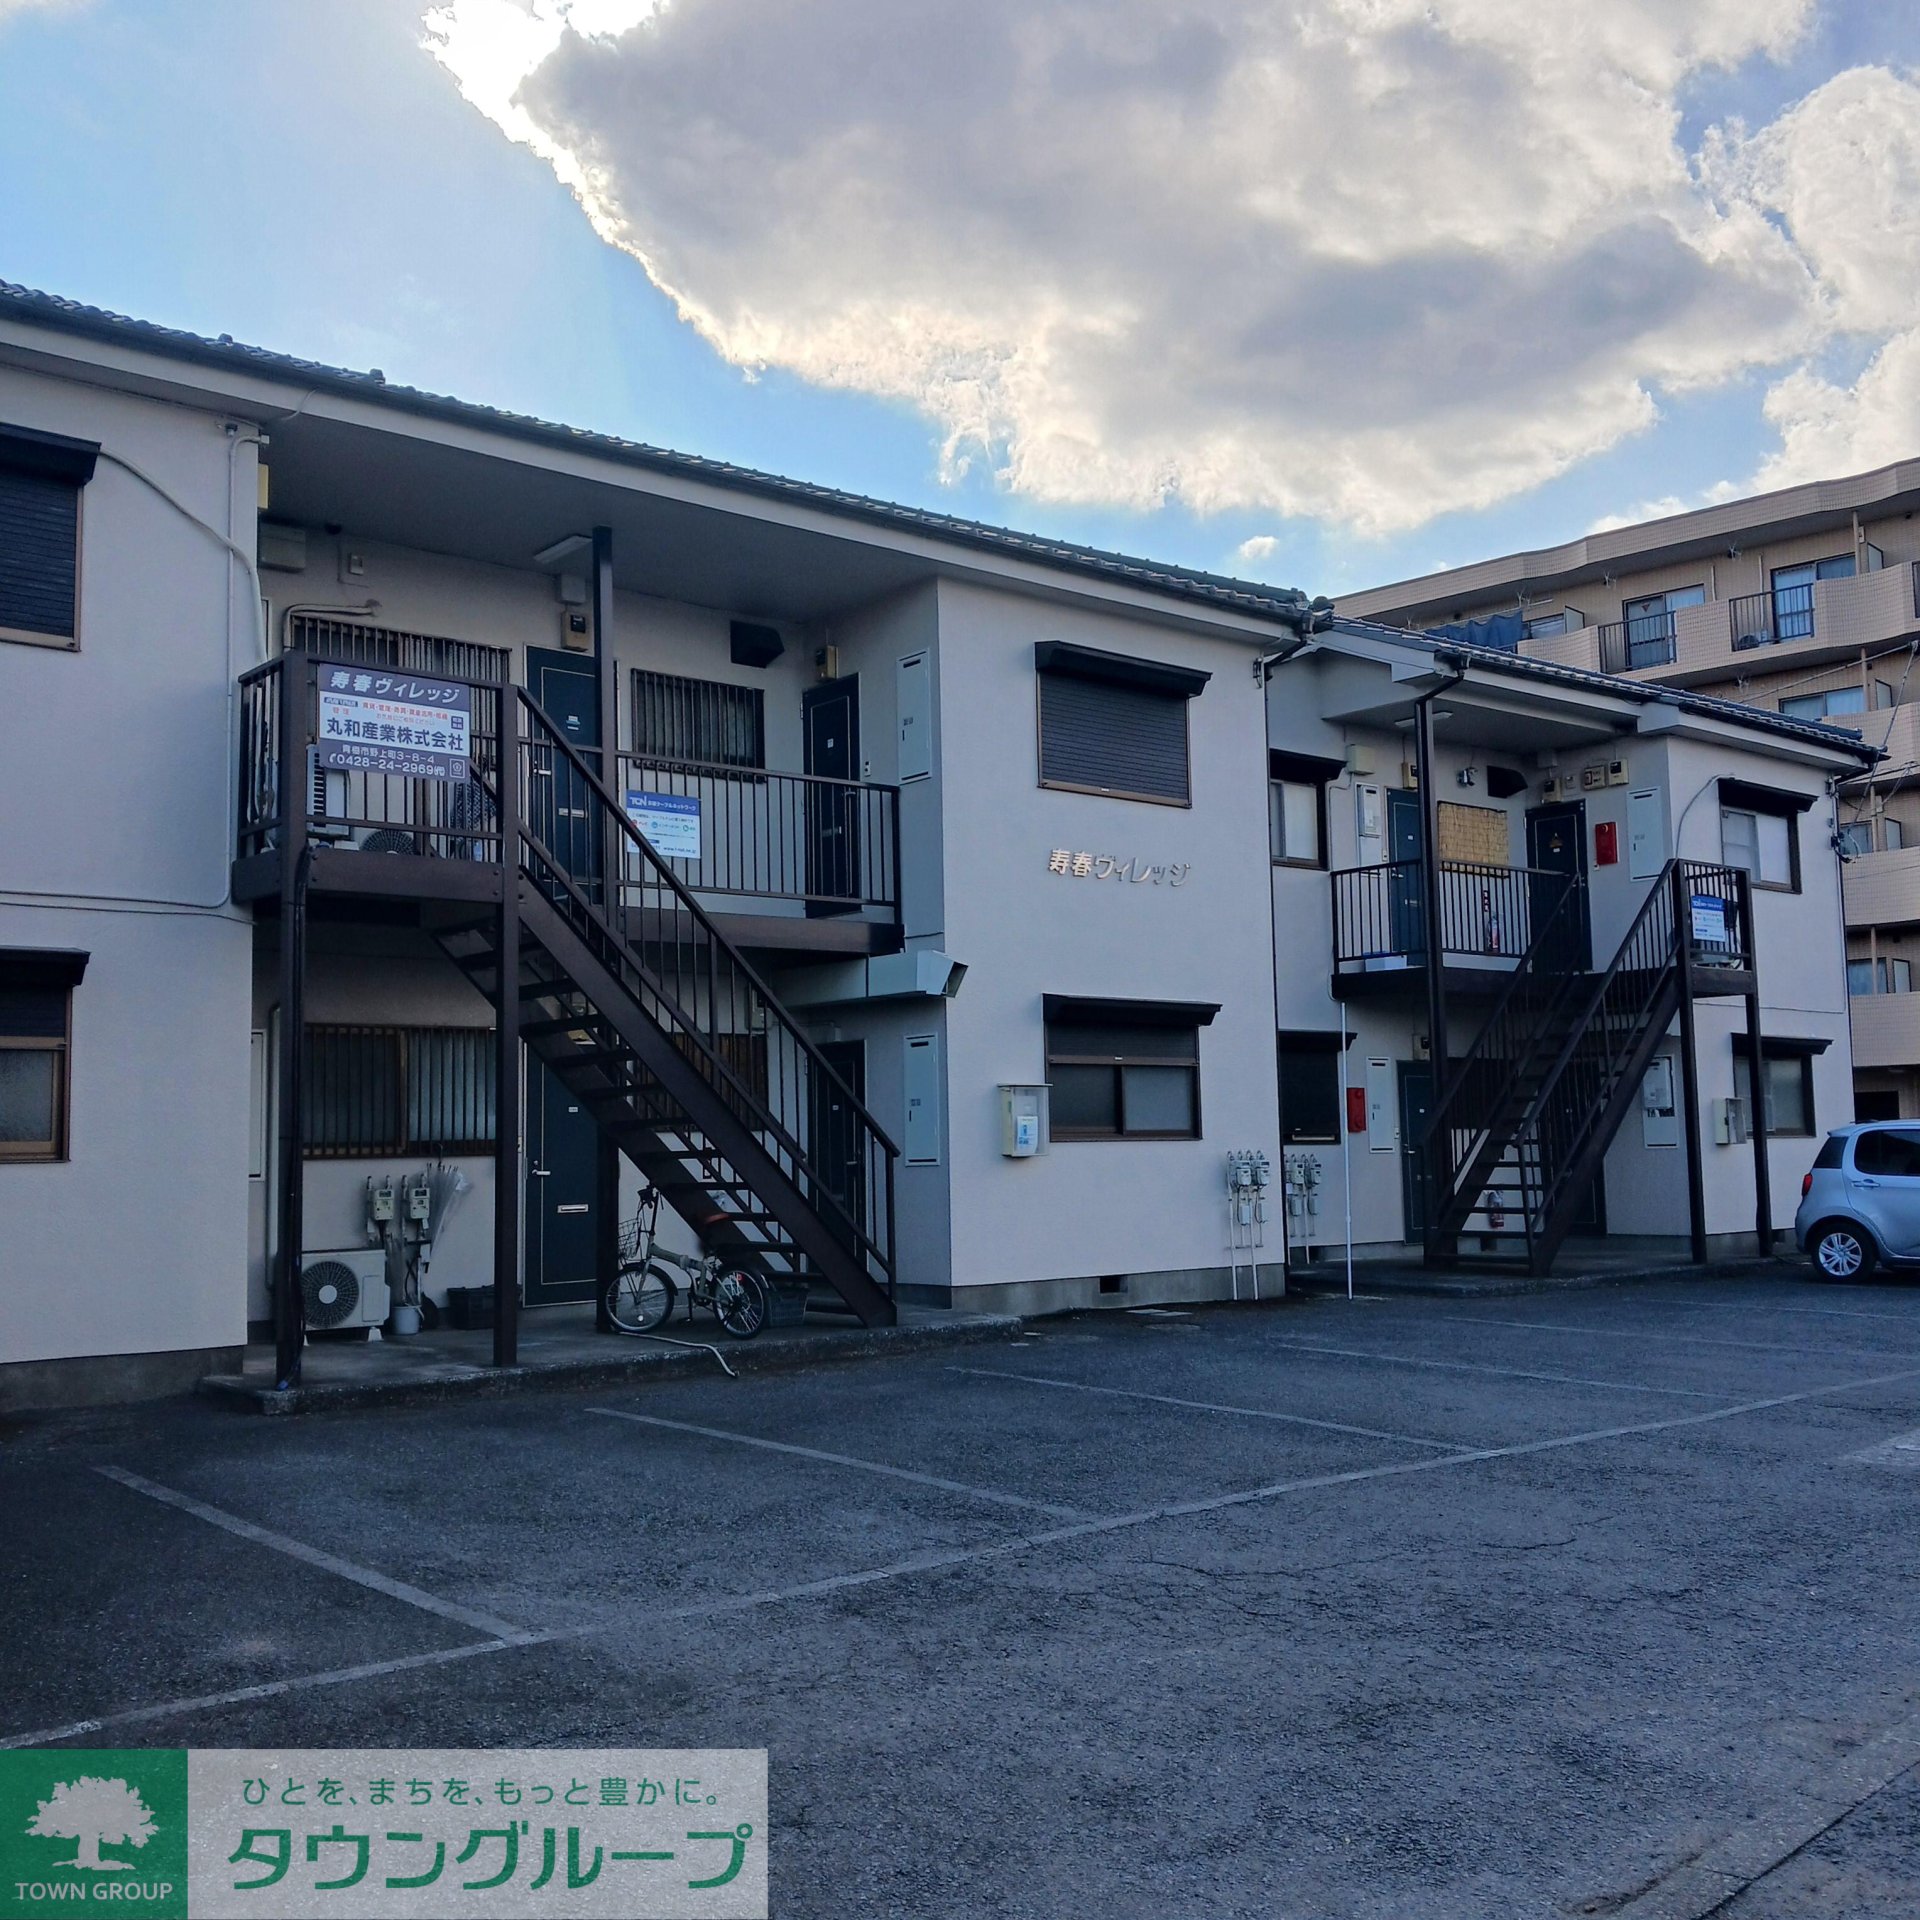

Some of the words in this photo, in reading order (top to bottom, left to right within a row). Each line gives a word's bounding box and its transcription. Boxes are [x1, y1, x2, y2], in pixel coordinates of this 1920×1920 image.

[330, 671, 460, 704] 寿春ヴィレッジ
[326, 717, 464, 751] 丸和産業株式会社
[1049, 848, 1191, 887] 寿春ヴィレッジ
